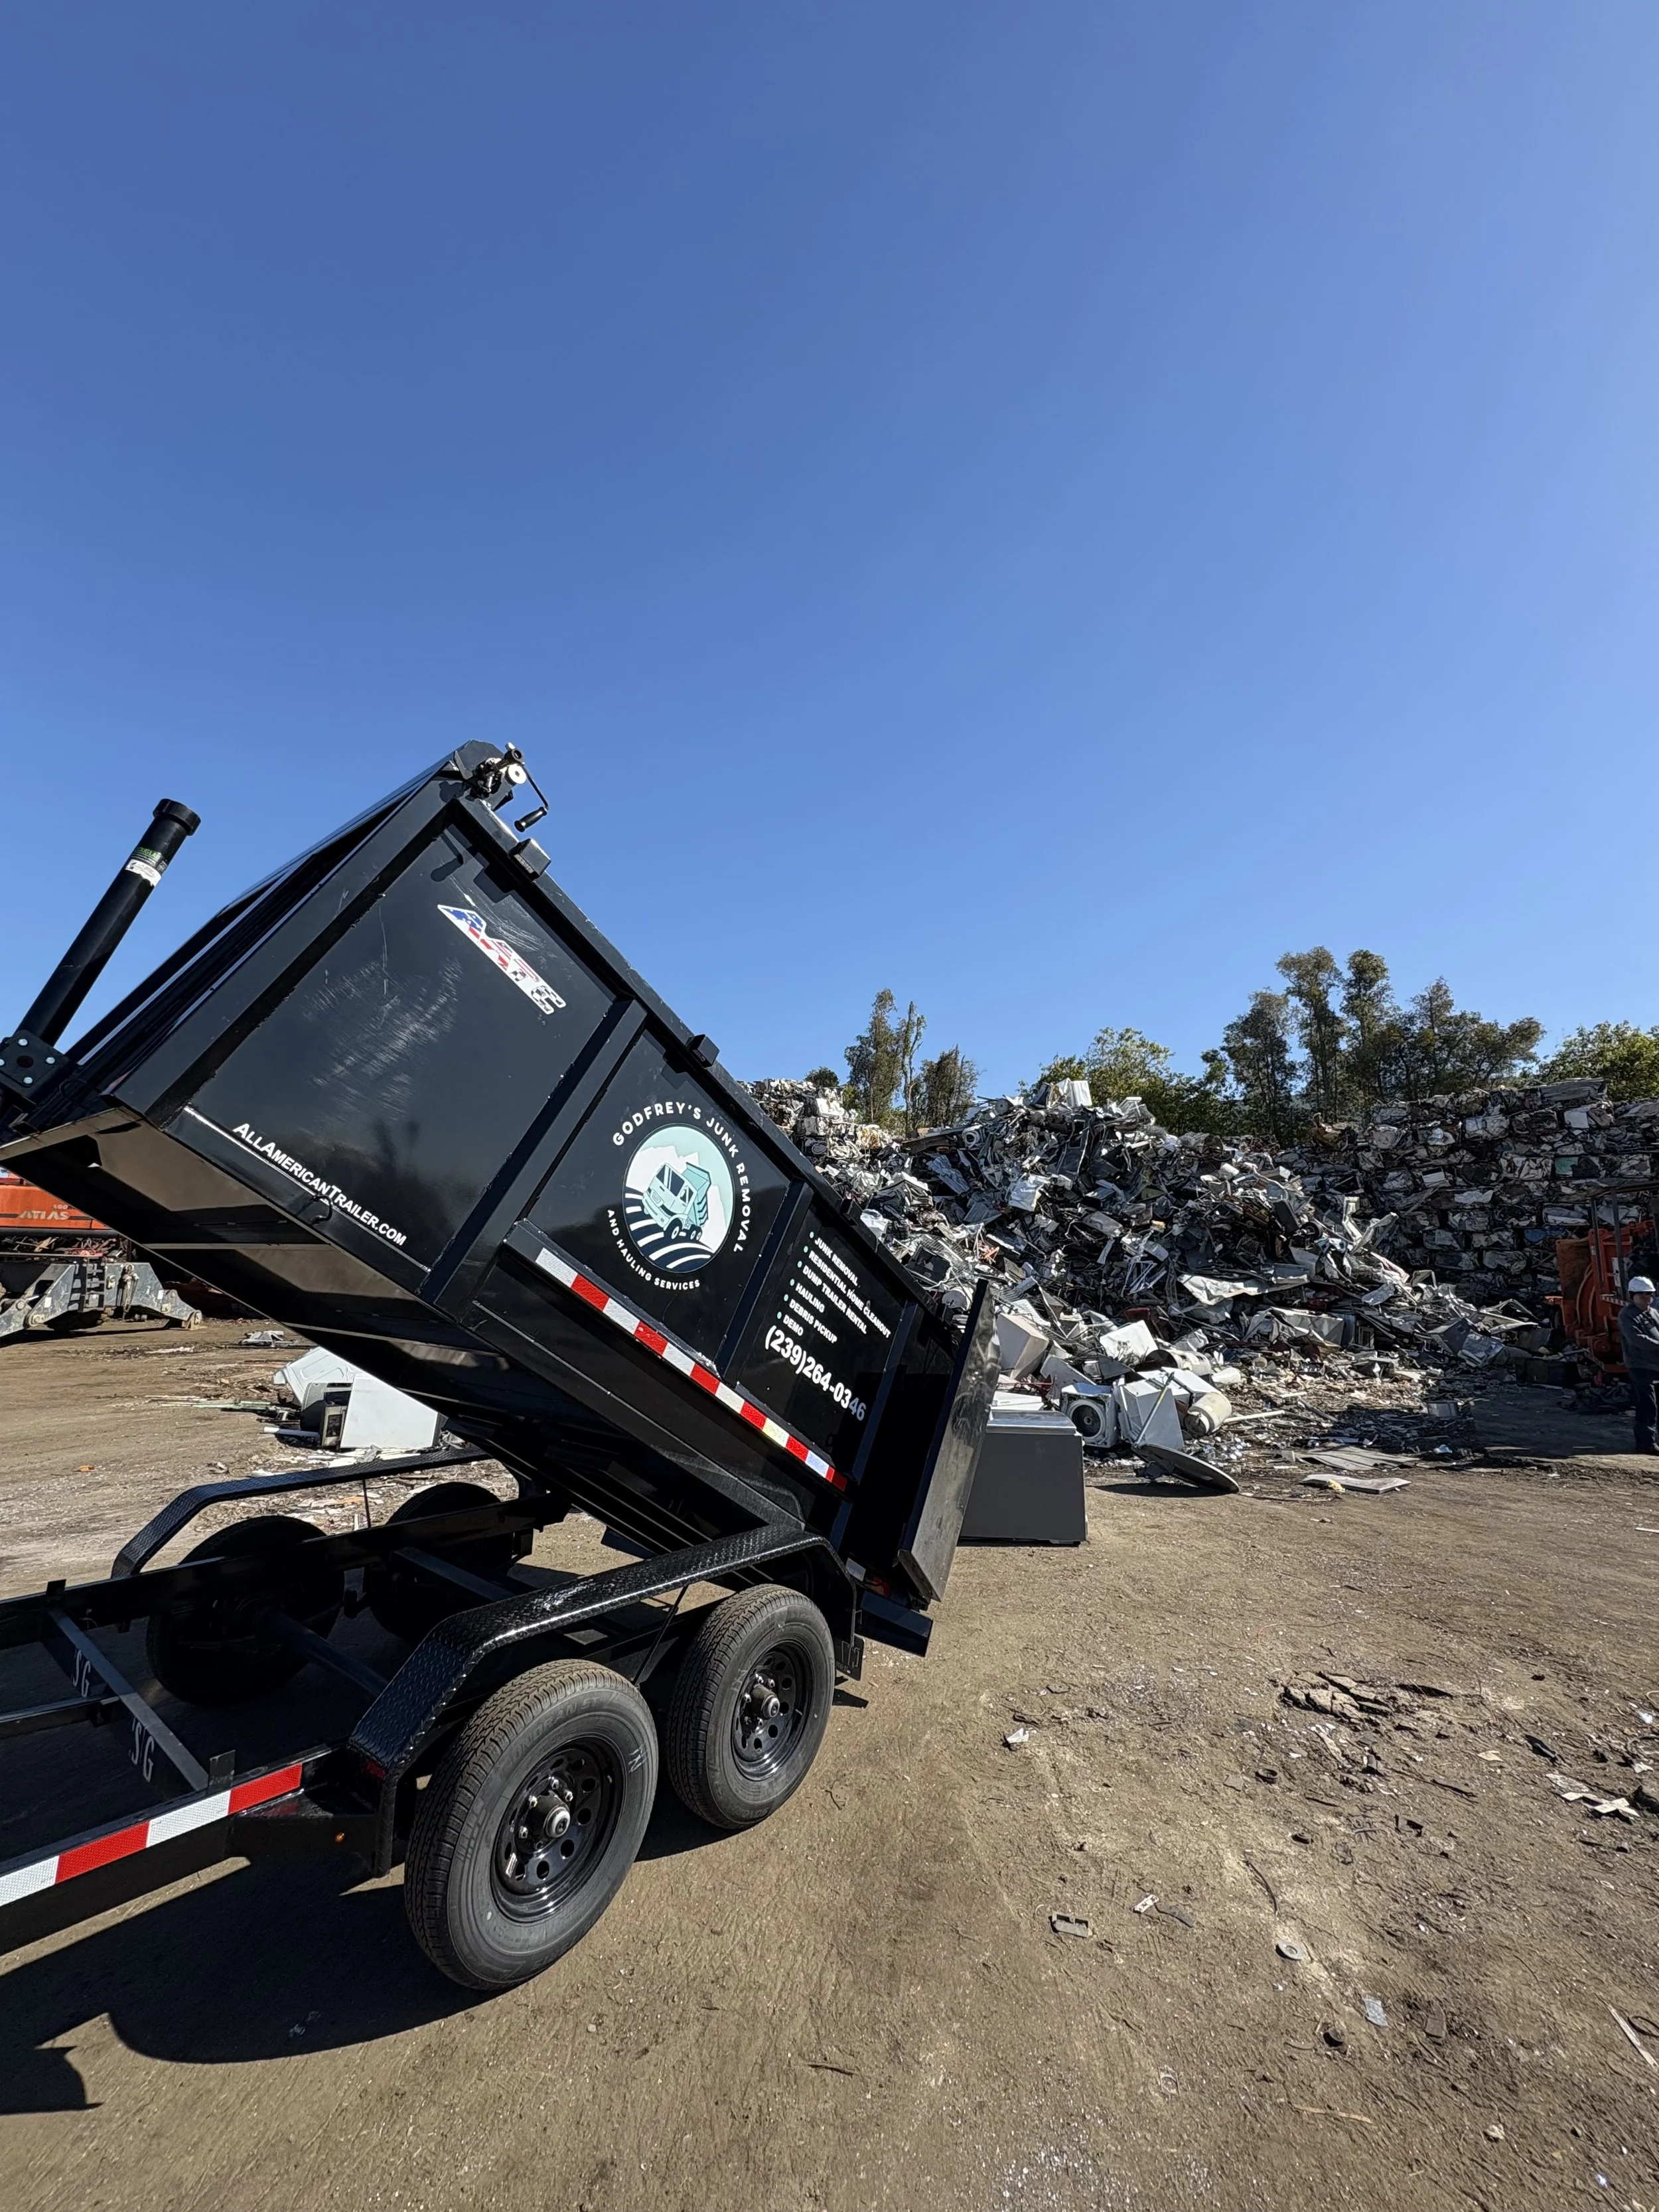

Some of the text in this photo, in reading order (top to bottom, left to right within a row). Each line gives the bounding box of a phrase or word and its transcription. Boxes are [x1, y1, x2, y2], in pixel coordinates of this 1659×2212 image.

[613, 1102, 751, 1252] GODFREY'S JUNK REMOVAL
[607, 1209, 700, 1290] AND HAULING SERVICES
[814, 1237, 858, 1286] JUNK REMOVAL
[782, 1315, 804, 1337] DEMO
[789, 1299, 837, 1344] DEBRIS PICKUP
[796, 1282, 826, 1313] HAULING
[802, 1265, 867, 1335] DUMP TRAILER RENTAL
[809, 1250, 891, 1339] RESIDENTIAL HOME CLEANOUT
[764, 1325, 867, 1422] (239)264-0346
